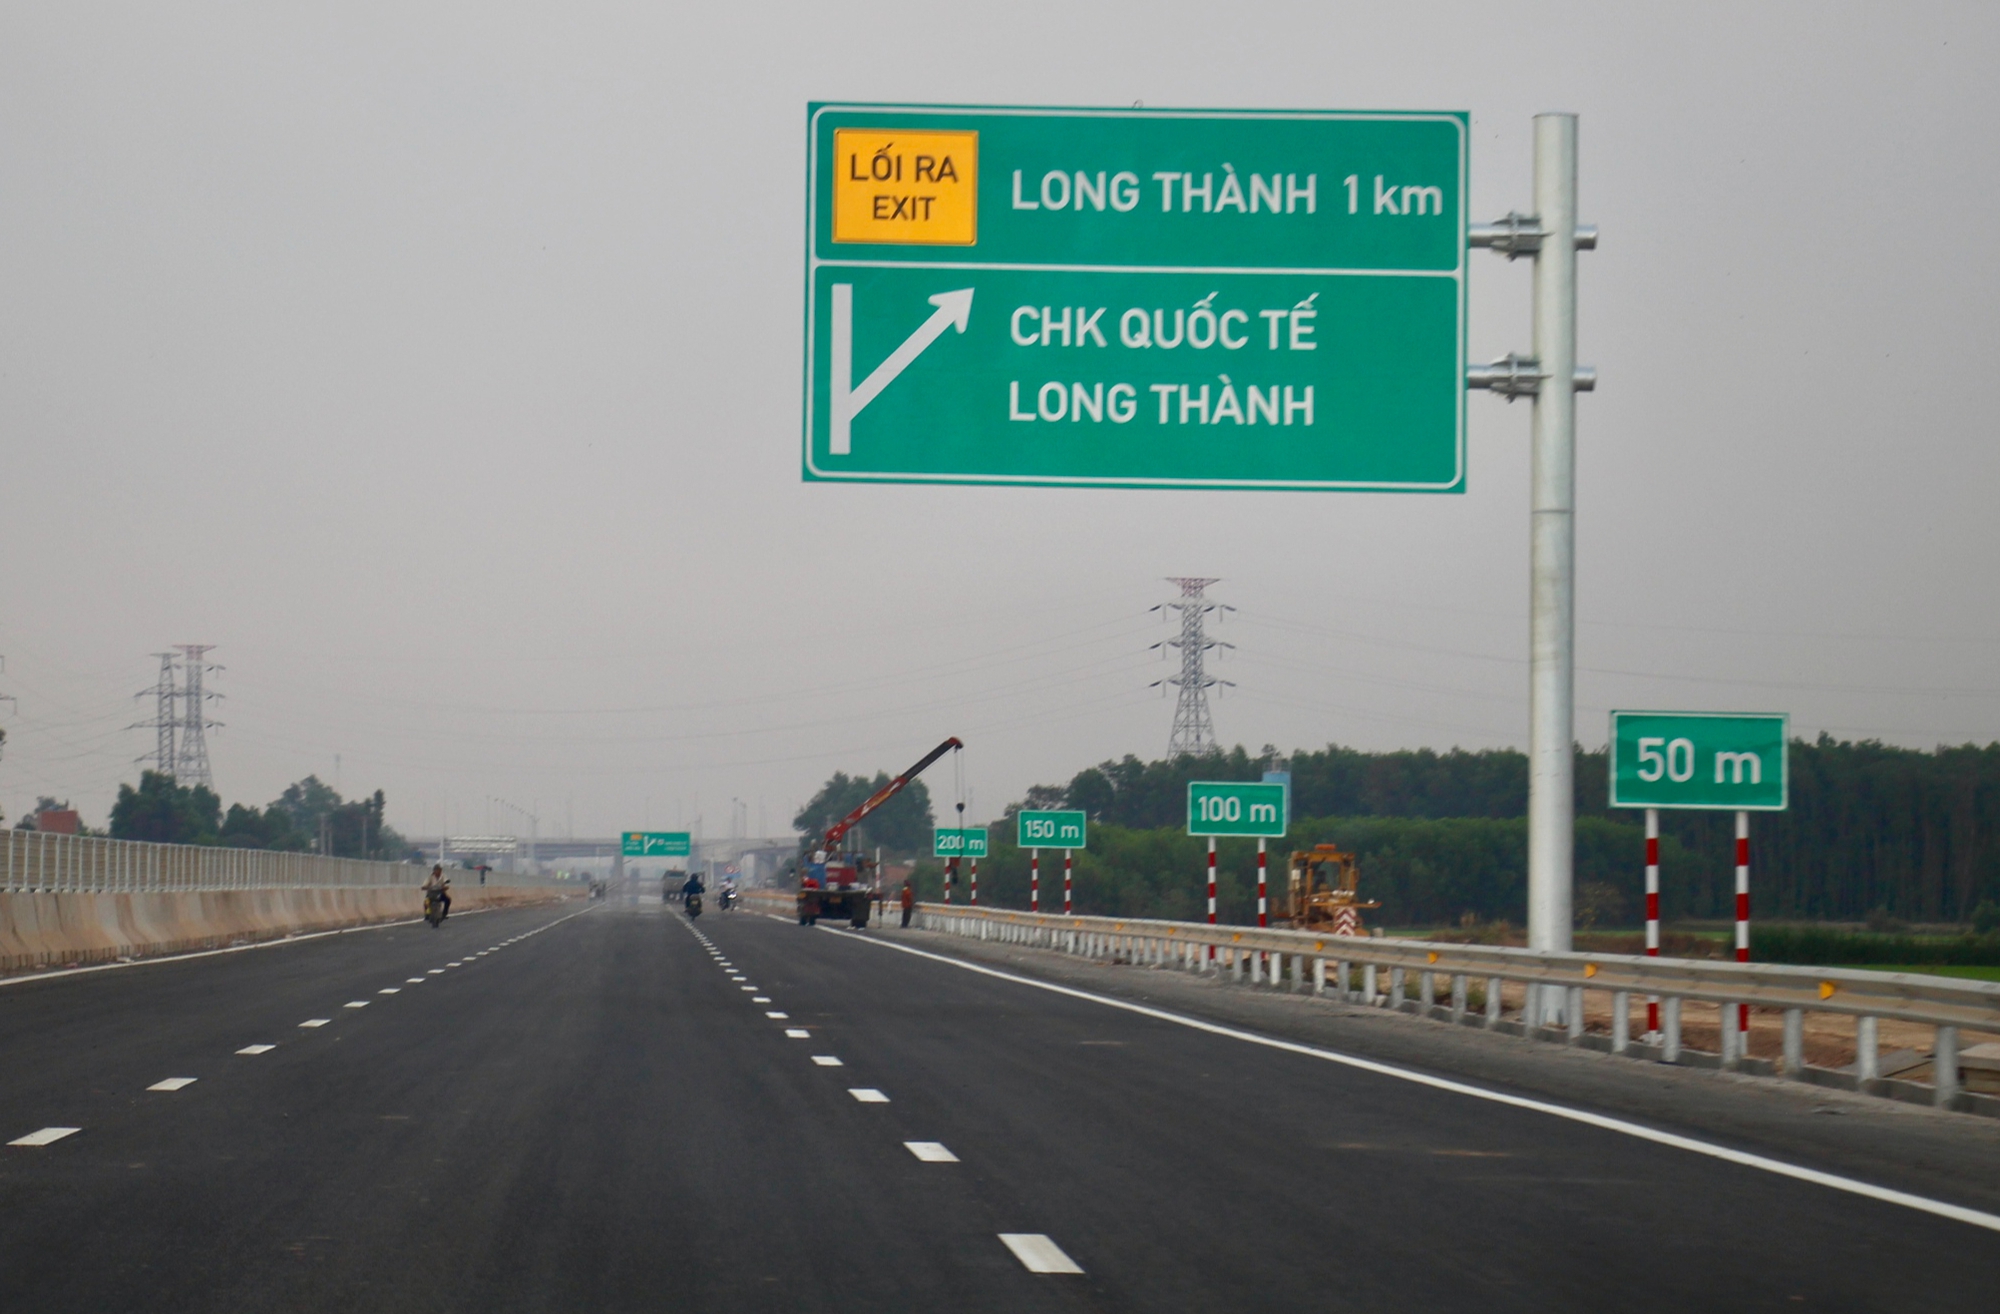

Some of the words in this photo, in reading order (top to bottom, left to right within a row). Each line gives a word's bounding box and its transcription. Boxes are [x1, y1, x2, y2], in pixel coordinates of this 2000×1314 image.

[850, 143, 902, 182] LỐI
[914, 155, 959, 183] RA
[872, 196, 937, 221] EXIT
[1011, 169, 1140, 212] LONG
[1152, 162, 1317, 214] THÀNH
[1344, 174, 1358, 214] 1
[1374, 175, 1443, 216] km
[1009, 305, 1107, 348] CHK
[1120, 291, 1250, 351] QUỐC
[1258, 292, 1319, 351] TẾ
[1008, 380, 1137, 423] LONG
[1149, 374, 1314, 426] THÀNH
[1637, 736, 1695, 783] 50
[1714, 750, 1762, 785] m
[1024, 819, 1055, 839] 150
[1060, 824, 1080, 839] m
[1198, 795, 1241, 822] 100
[1249, 803, 1276, 823] m
[937, 835, 965, 850] 200
[968, 839, 985, 850] m
